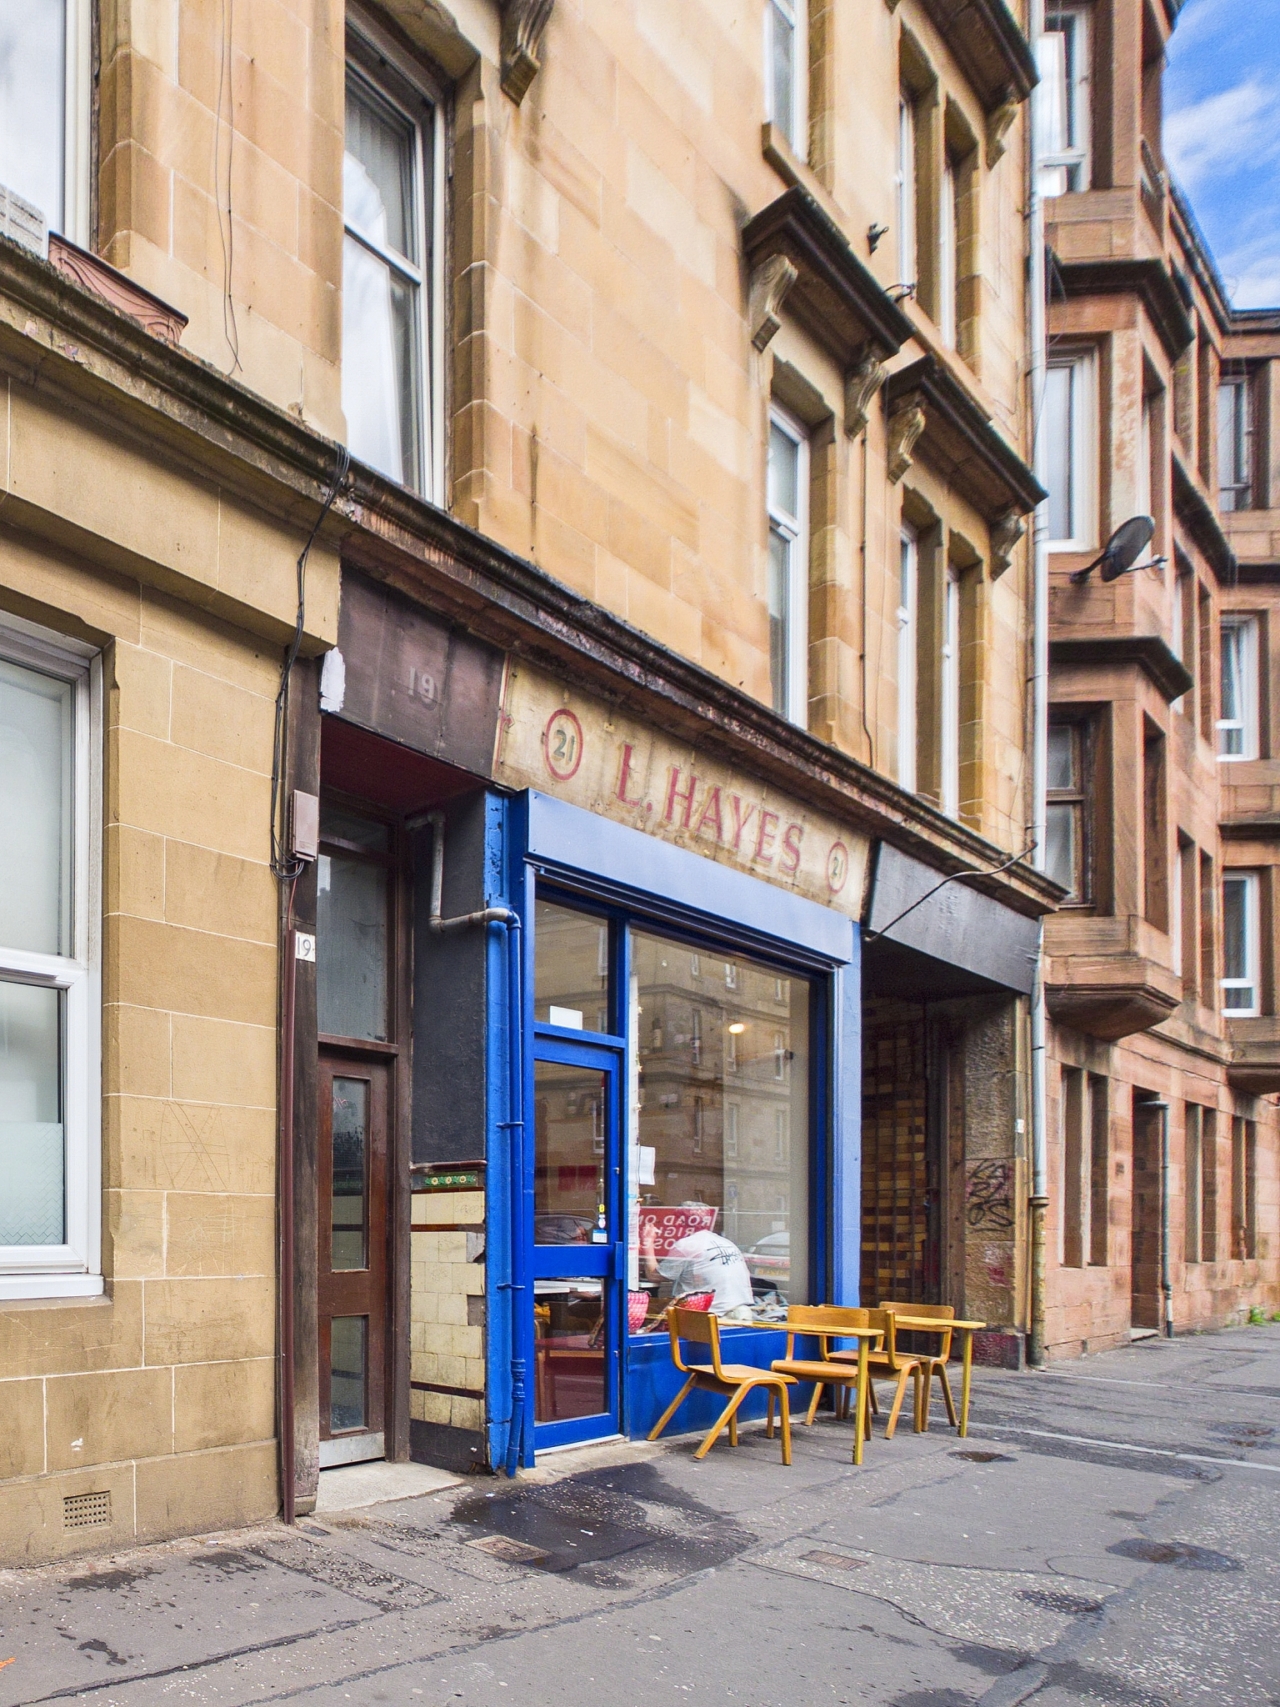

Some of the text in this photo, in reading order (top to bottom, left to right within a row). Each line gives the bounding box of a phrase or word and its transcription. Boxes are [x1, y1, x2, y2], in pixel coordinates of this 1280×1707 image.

[407, 666, 435, 705] 19
[552, 729, 576, 763] 21
[616, 743, 804, 873] L. HAYES
[297, 936, 312, 957] 19
